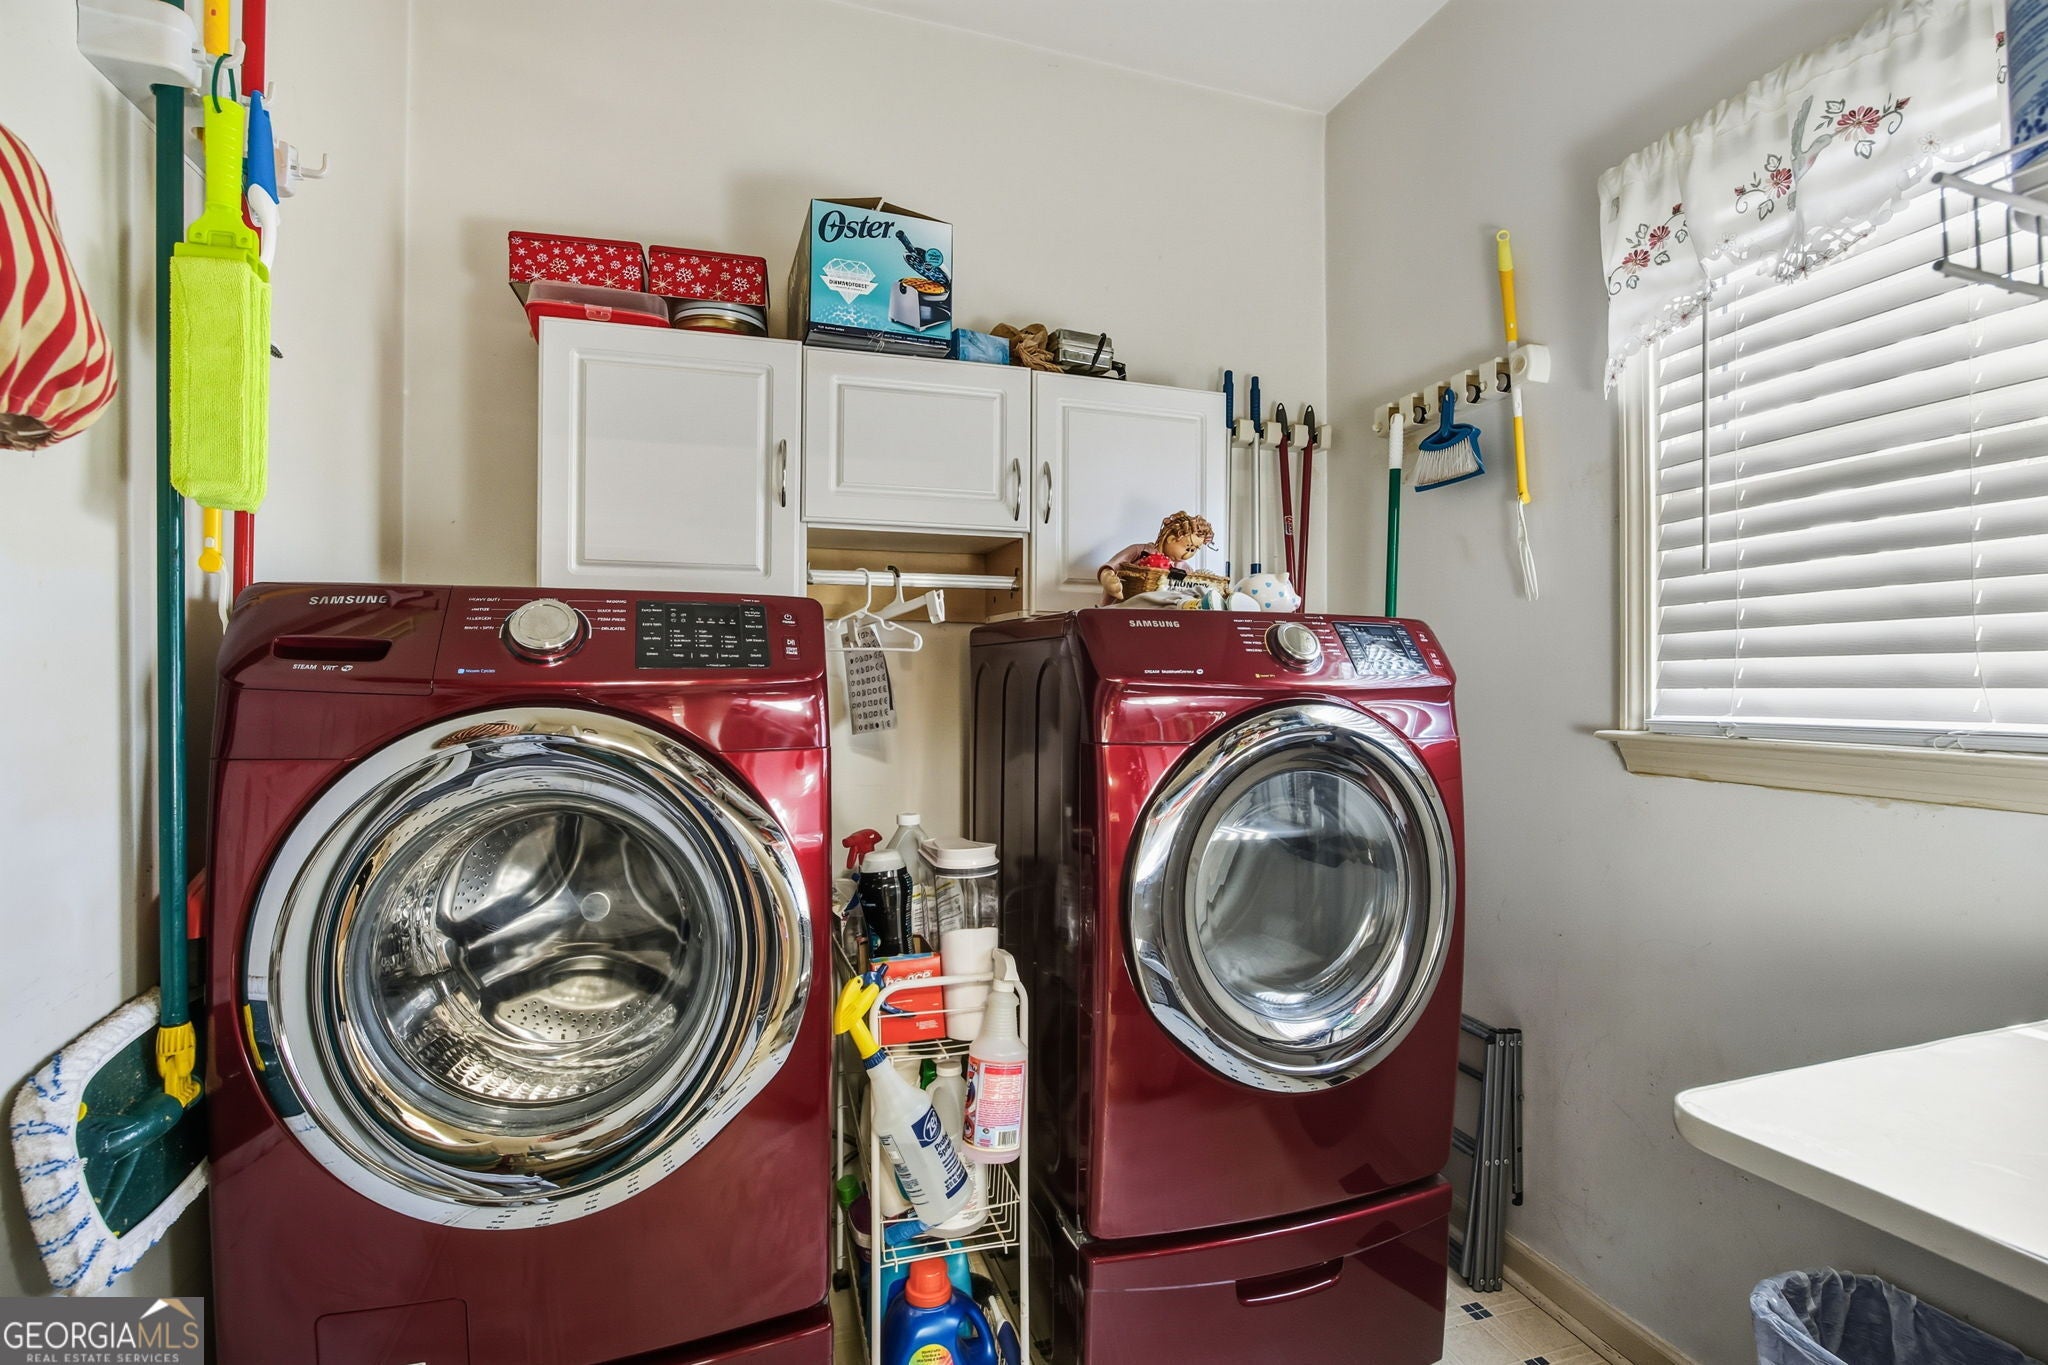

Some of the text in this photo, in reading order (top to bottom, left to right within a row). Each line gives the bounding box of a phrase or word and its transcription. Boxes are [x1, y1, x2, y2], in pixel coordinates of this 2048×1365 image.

[818, 210, 895, 243] Oster
[309, 595, 388, 605] SAMSUNG
[1129, 619, 1180, 628] SAMSUNG
